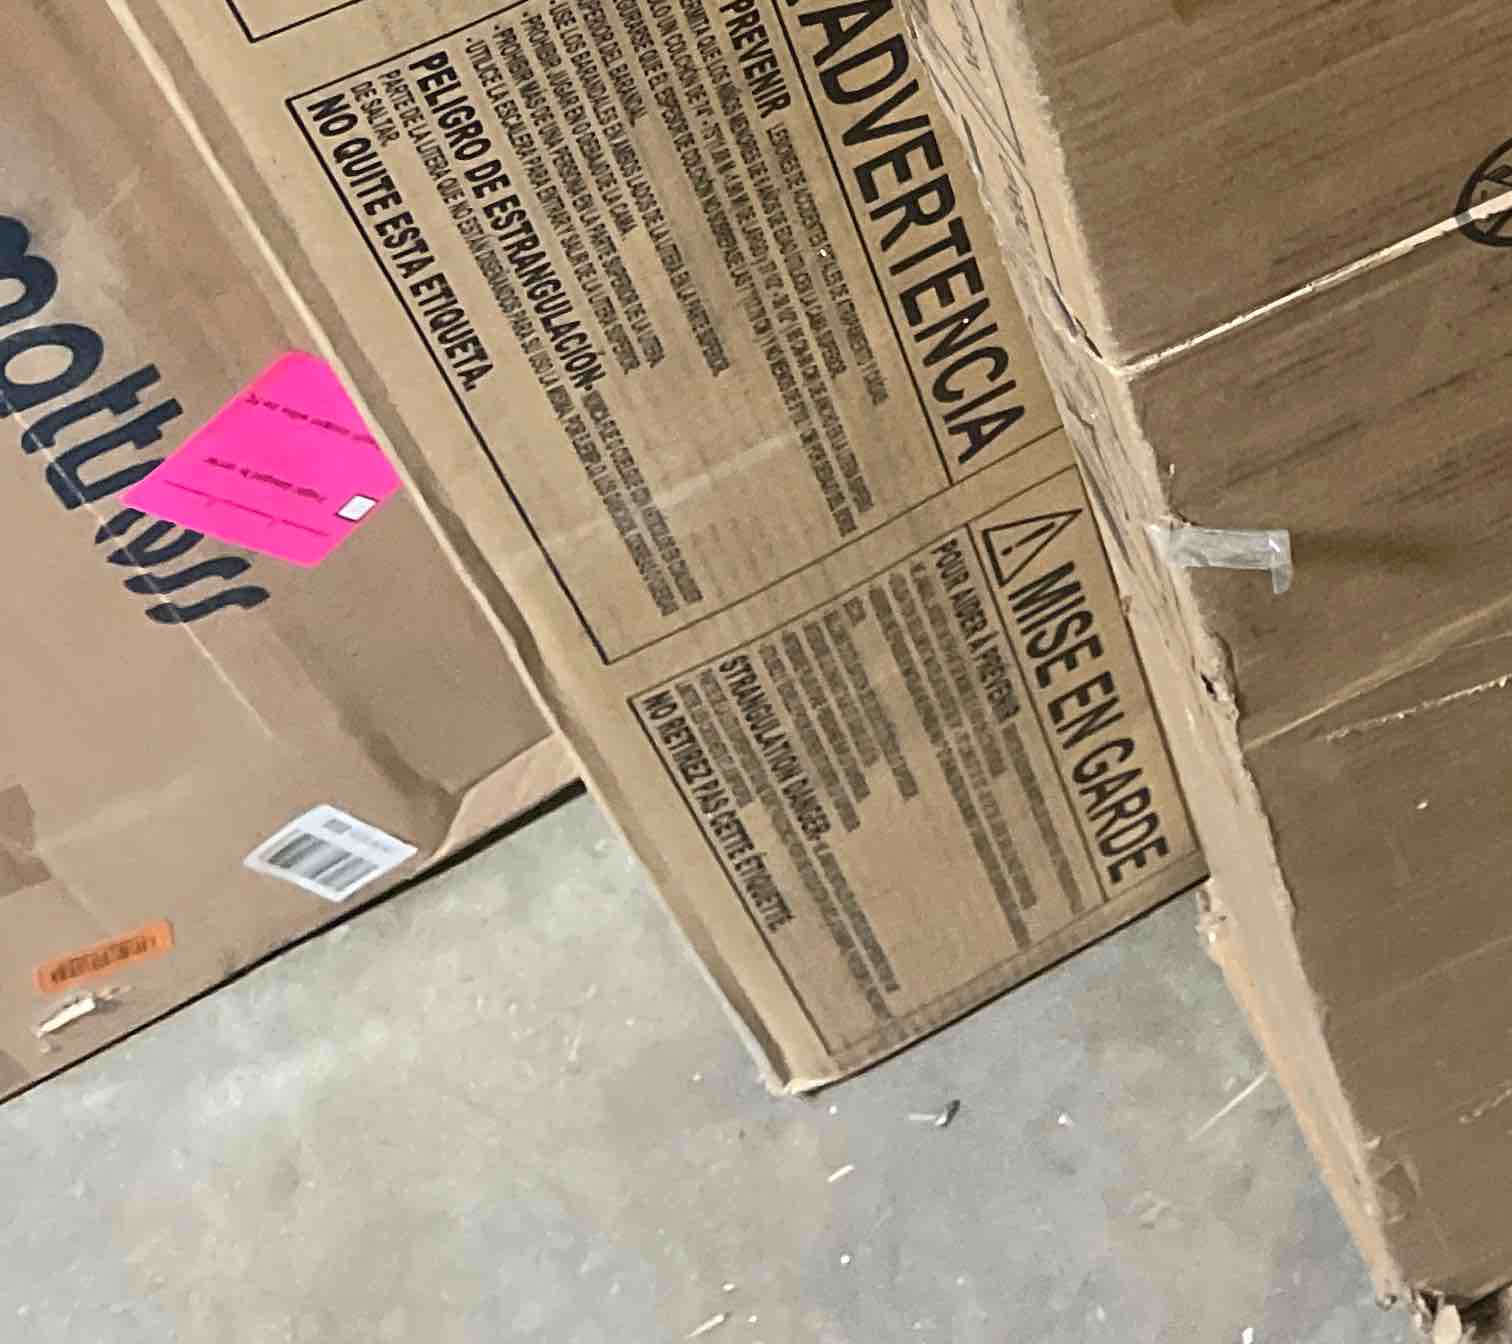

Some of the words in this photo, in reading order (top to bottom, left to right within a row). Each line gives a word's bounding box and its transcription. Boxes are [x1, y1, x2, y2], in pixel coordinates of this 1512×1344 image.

[407, 50, 492, 162] PELIGRO
[463, 157, 512, 200] DE
[305, 92, 359, 138] NO
[332, 136, 404, 217] QUITE
[372, 210, 436, 280] ESTA
[407, 271, 494, 393] ETIQUETA.
[1007, 559, 1105, 690] MISE
[1046, 669, 1126, 751] EN
[1071, 736, 1171, 886] GARDE
